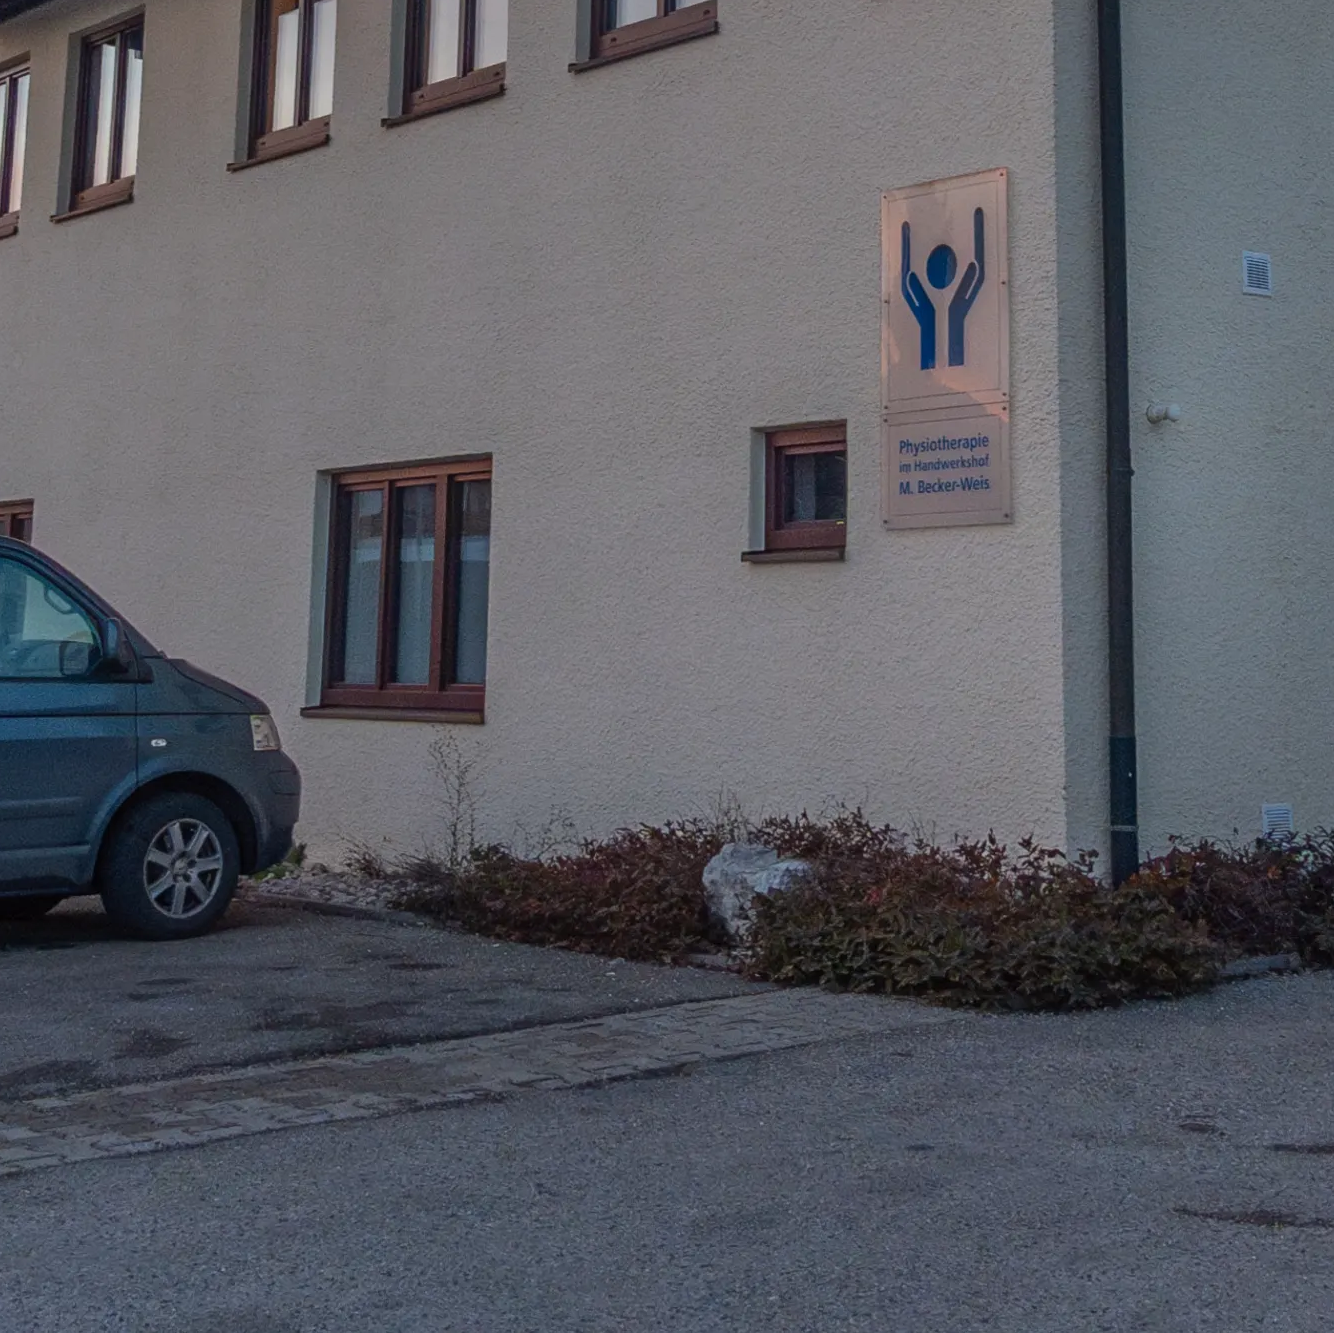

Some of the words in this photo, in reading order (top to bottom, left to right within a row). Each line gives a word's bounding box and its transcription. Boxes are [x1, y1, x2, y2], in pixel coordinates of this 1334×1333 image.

[898, 432, 990, 456] Physiotherapie
[899, 460, 912, 473] im
[914, 453, 990, 471] Handwerkshof
[899, 481, 914, 495] M.
[917, 475, 991, 494] Becker-Weis
